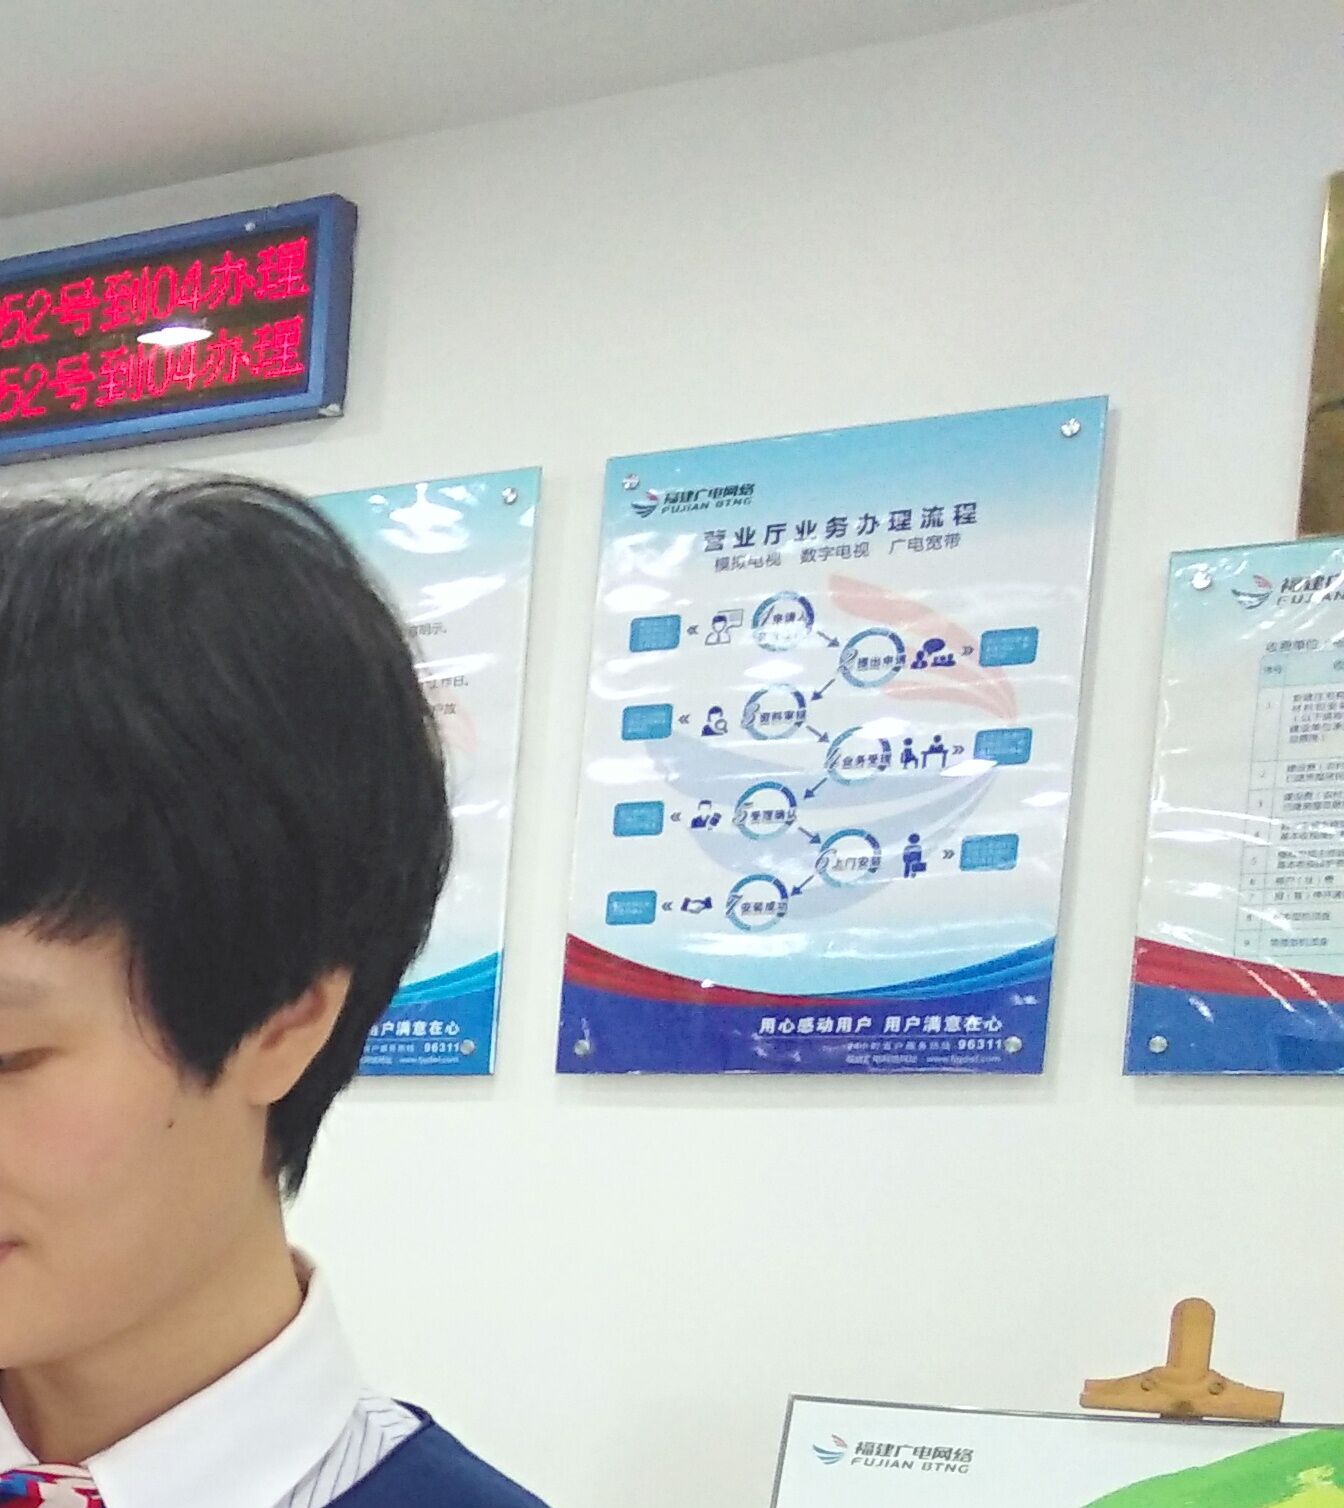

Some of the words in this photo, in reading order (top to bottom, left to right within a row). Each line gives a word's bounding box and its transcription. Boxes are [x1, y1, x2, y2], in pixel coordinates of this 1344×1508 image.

[663, 484, 755, 505] 福建广电网络
[704, 502, 979, 553] 营业厅业务办理流程
[800, 541, 870, 564] 数字电视
[888, 532, 962, 556] 广电宽带
[758, 1016, 872, 1034] 用心感动用户
[883, 1015, 1003, 1034] 用户满意在心
[958, 1037, 1003, 1050] 96311
[853, 1440, 975, 1463] 福建广电网络
[851, 1455, 914, 1472] FUJIAN
[921, 1461, 970, 1475] BTNG
